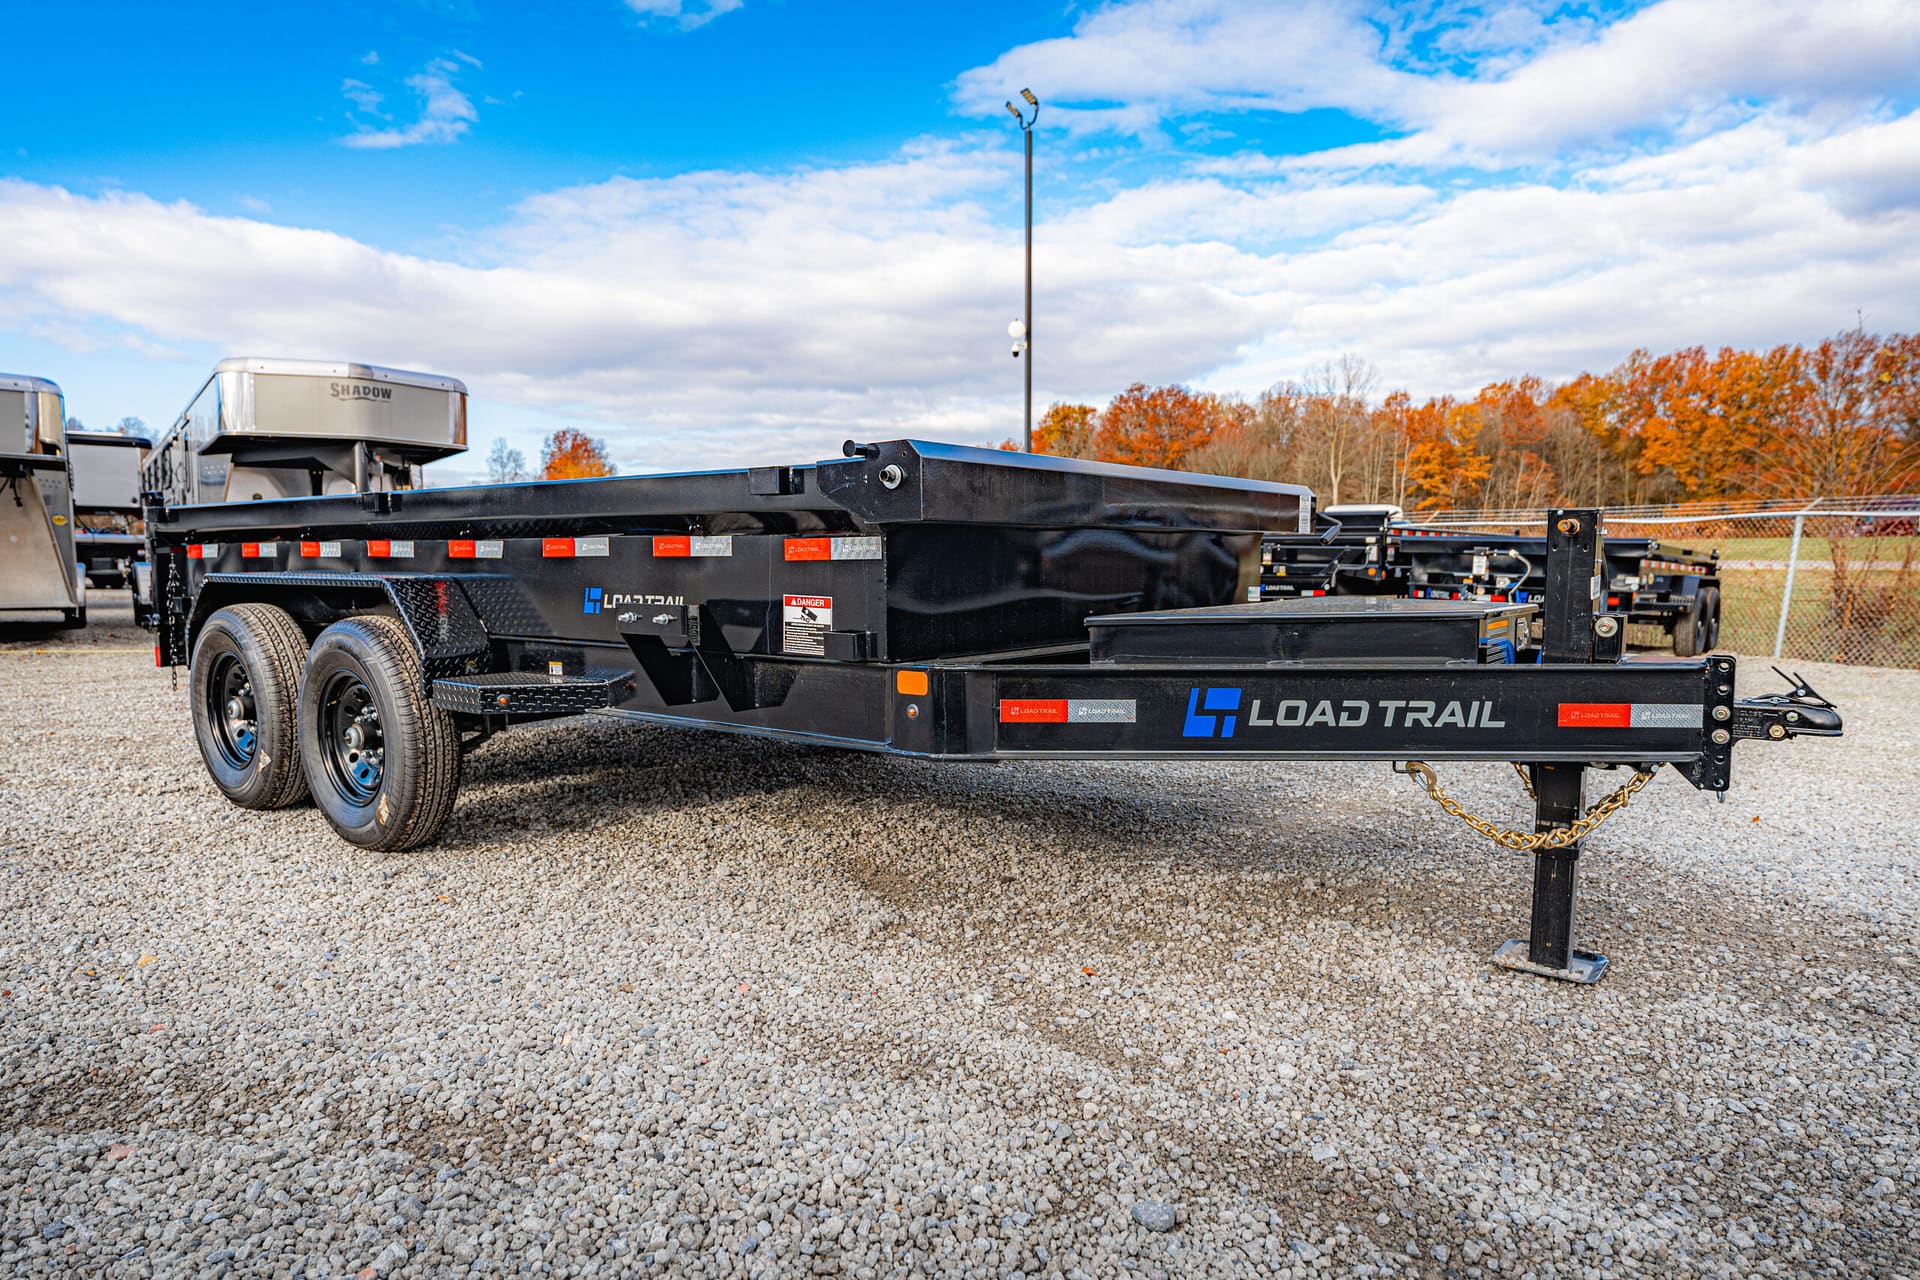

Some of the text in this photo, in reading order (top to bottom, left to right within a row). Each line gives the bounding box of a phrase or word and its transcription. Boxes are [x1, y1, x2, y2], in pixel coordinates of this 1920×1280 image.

[330, 382, 393, 399] SHADOW
[796, 597, 825, 607] DANGER
[1248, 699, 1506, 728] LOAD TRAIL
